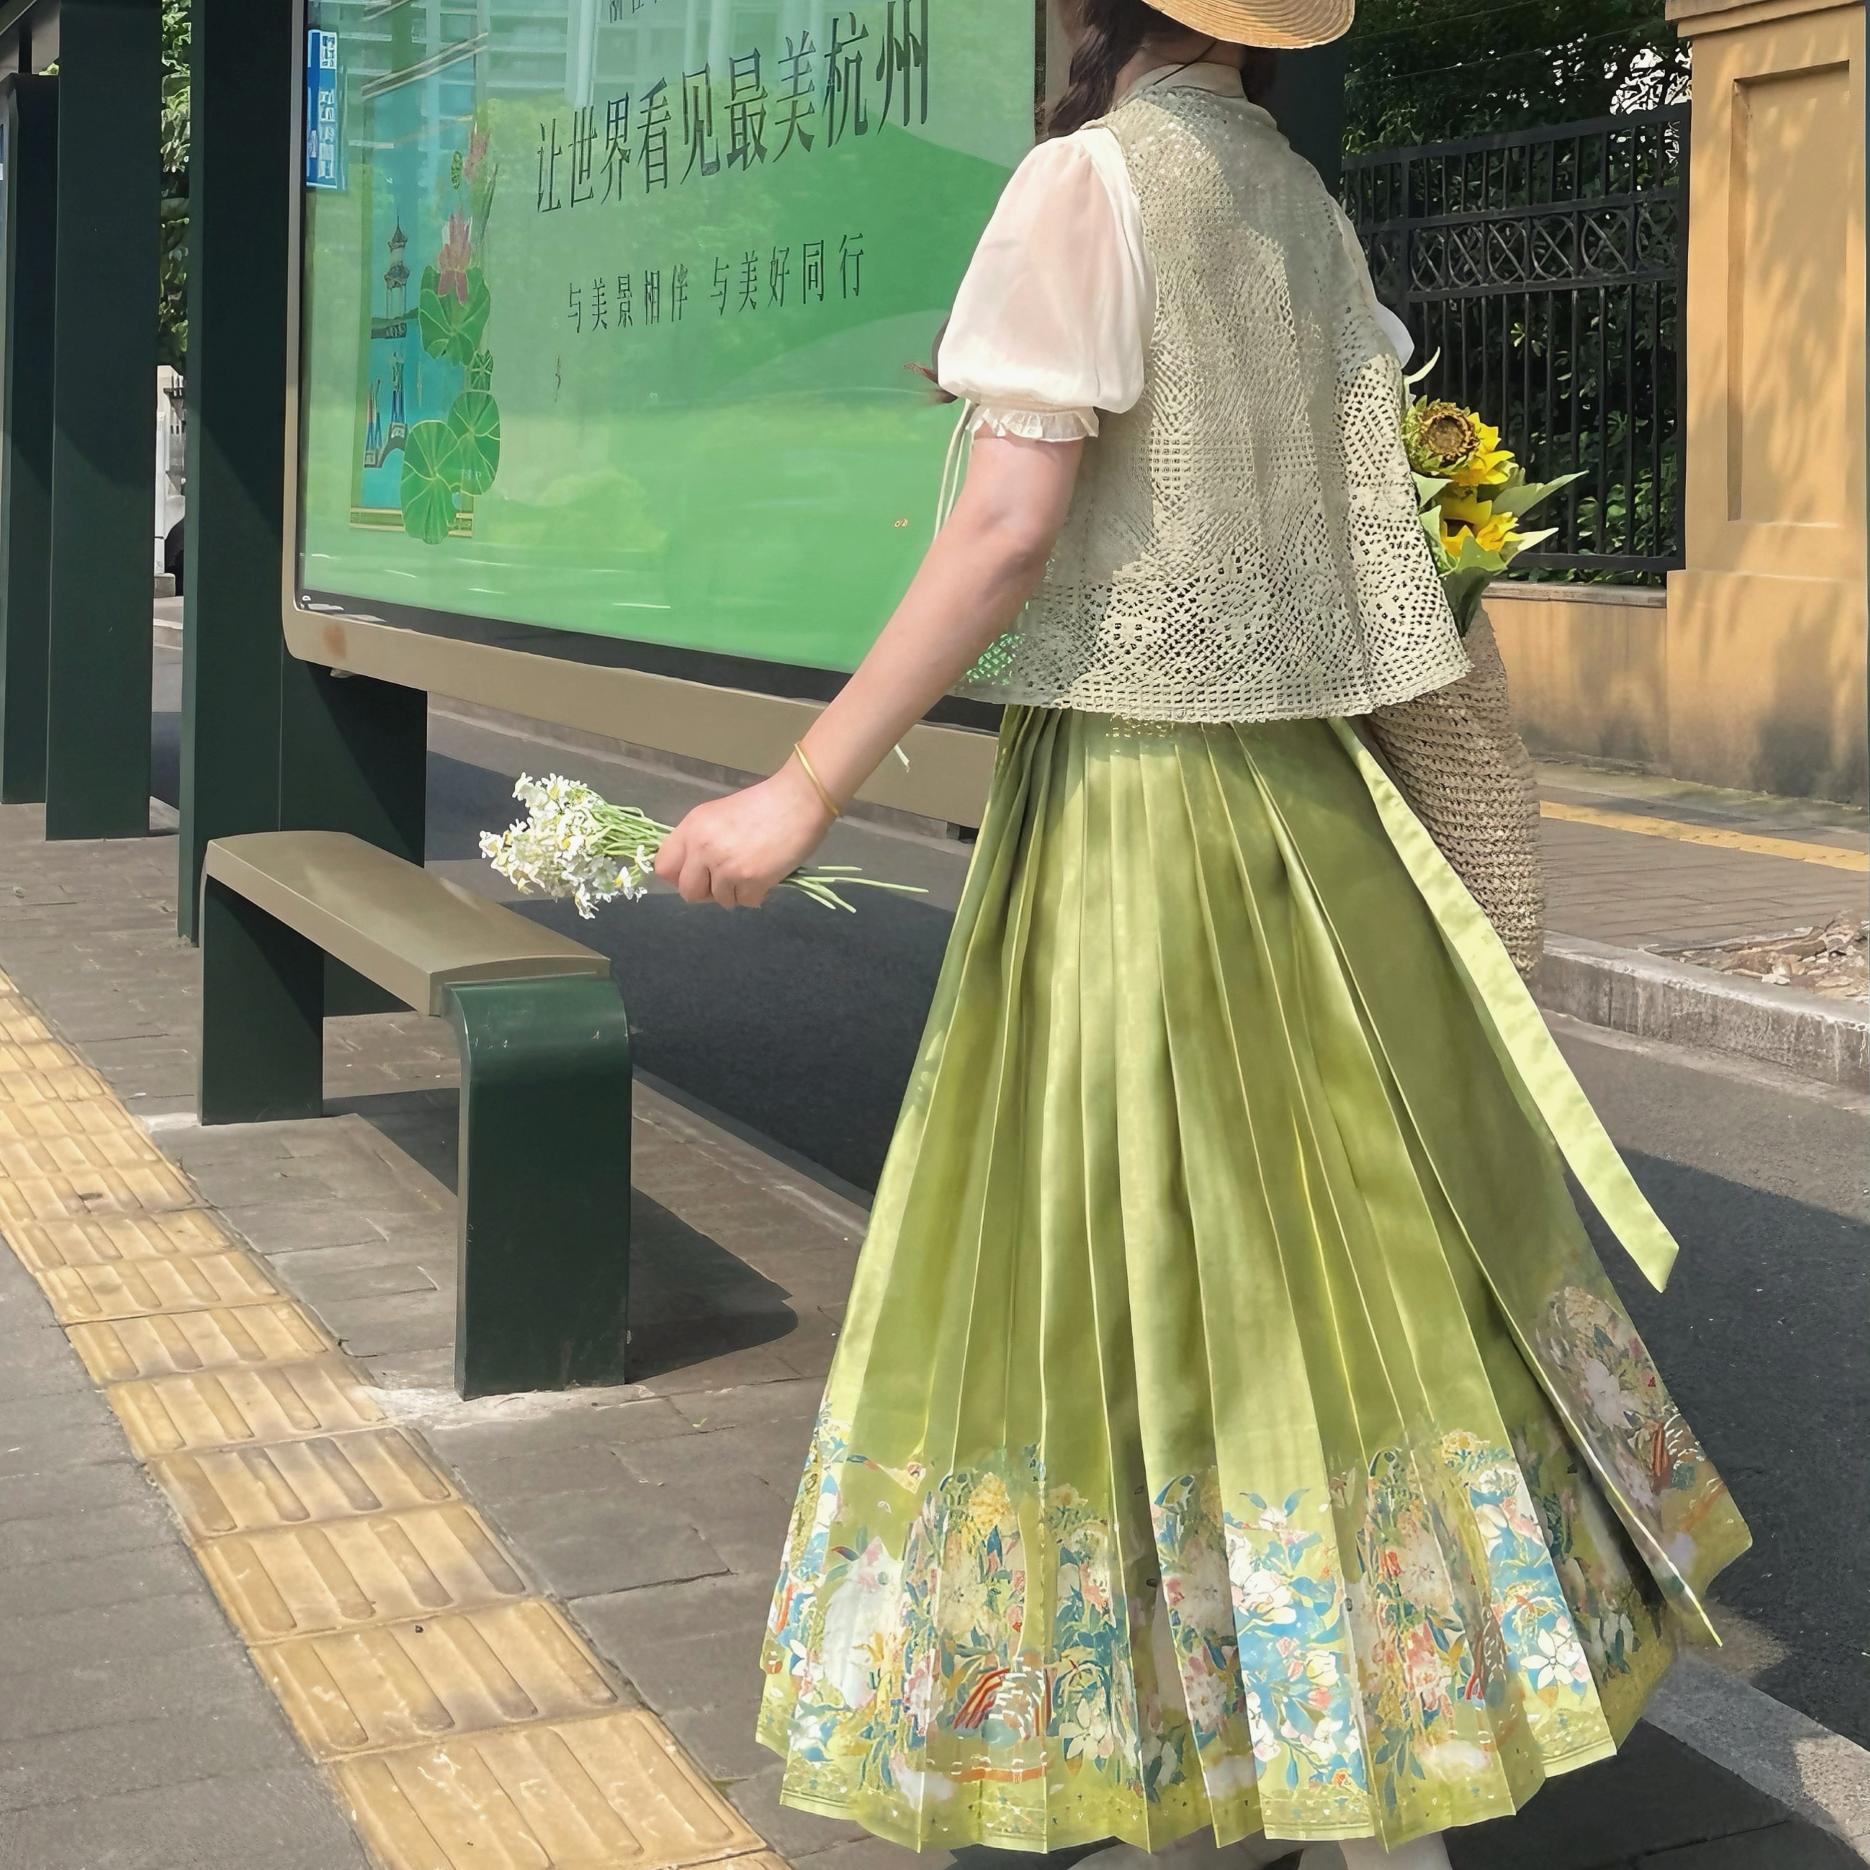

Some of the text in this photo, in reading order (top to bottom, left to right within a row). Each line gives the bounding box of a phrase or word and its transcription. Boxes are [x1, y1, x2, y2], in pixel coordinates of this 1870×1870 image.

[536, 0, 930, 213] 让世界看见最美杭州
[567, 233, 864, 333] 与美景相伴 与美好同行
